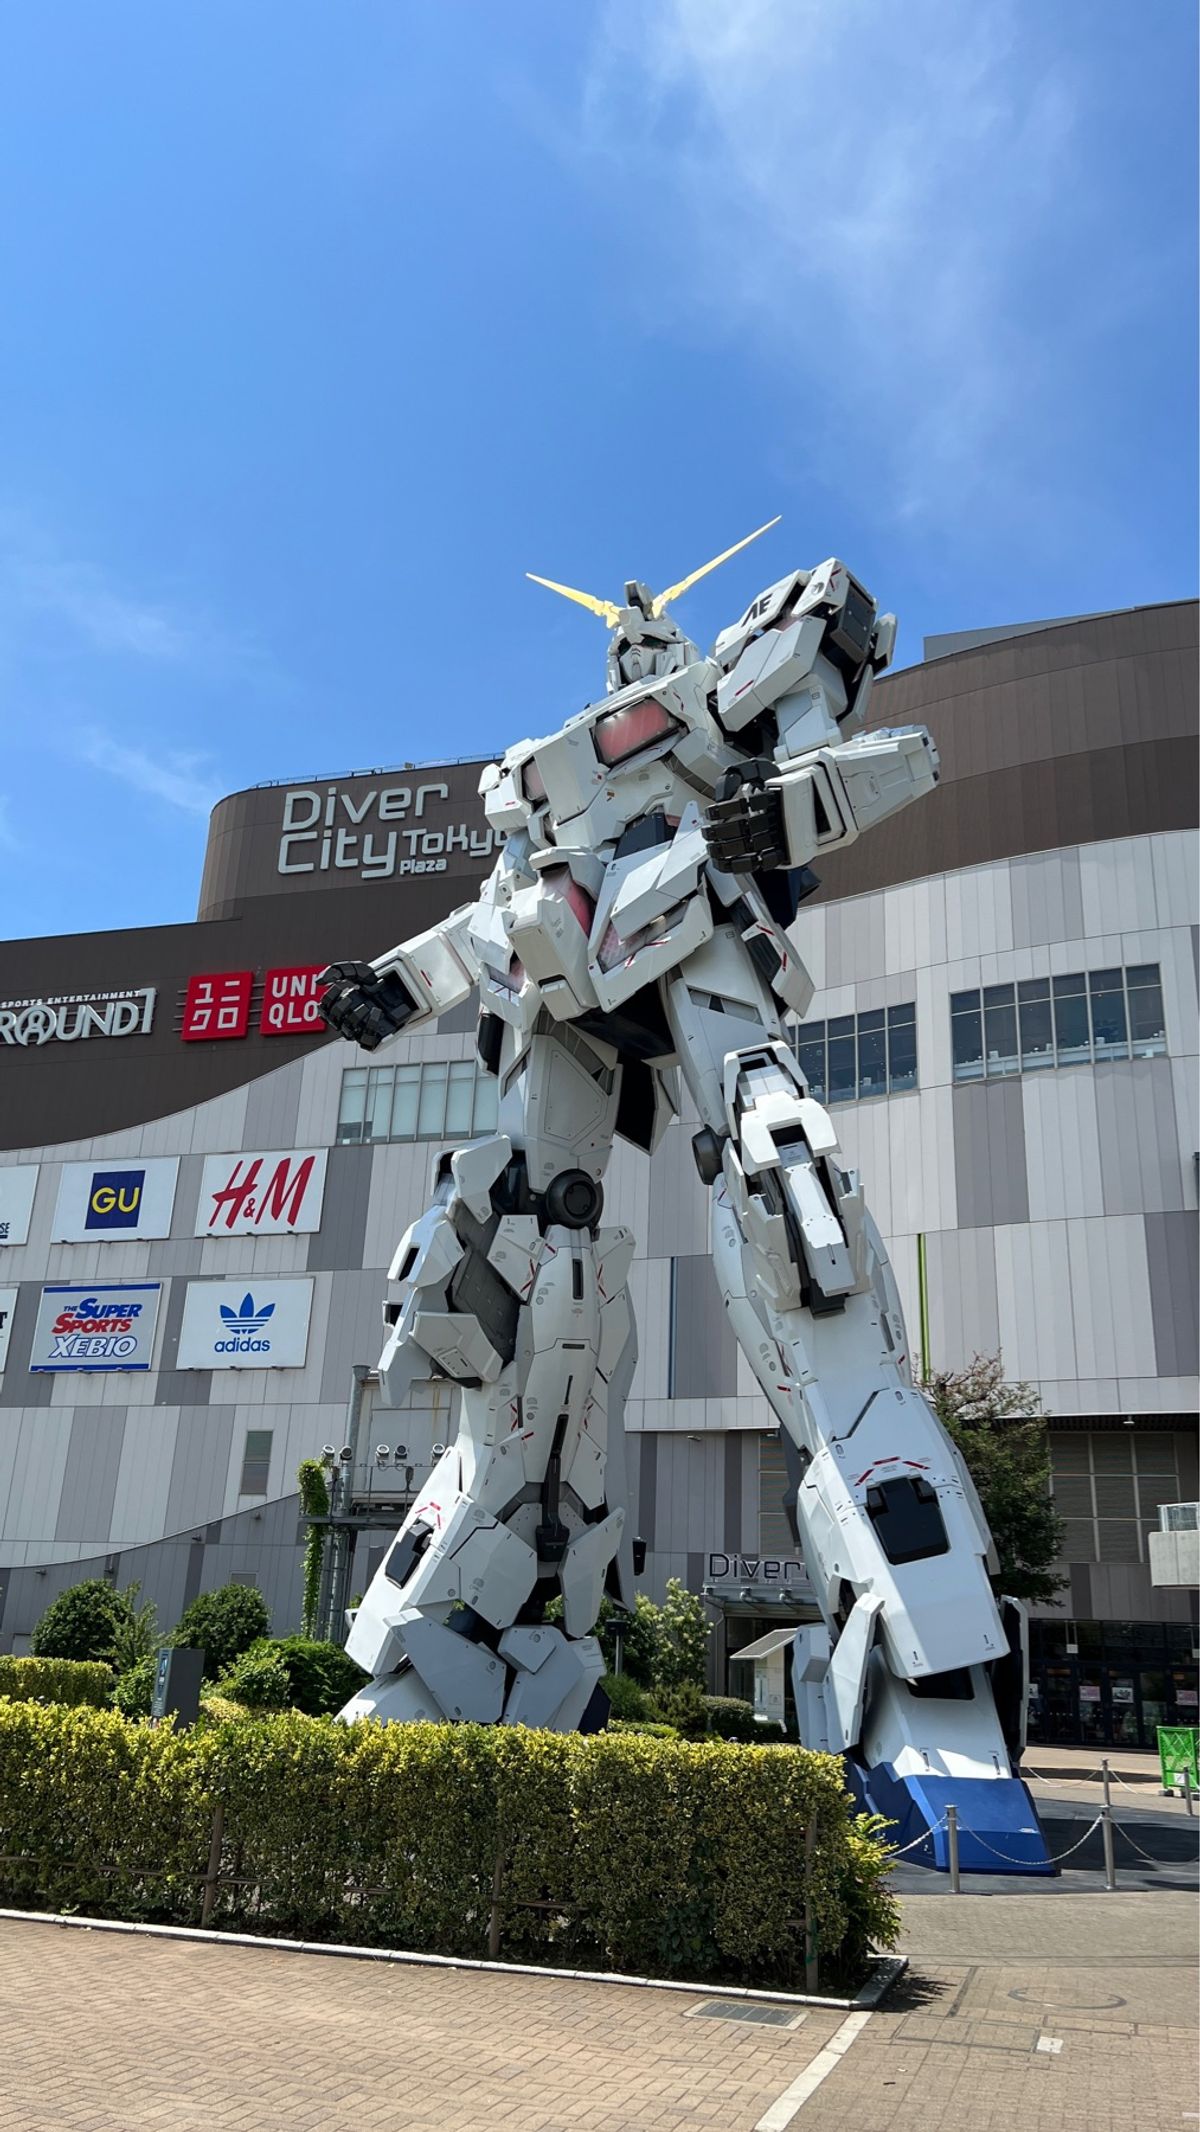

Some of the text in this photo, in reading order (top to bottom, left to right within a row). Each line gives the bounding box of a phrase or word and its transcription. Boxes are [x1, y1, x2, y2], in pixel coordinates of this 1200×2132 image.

[282, 783, 448, 831] Diver
[278, 828, 397, 879] City
[400, 858, 447, 875] Plaza
[272, 974, 318, 998] UNI
[1, 990, 141, 1009] SPORTS ENTERTAINMENT
[268, 1000, 321, 1028] QLO
[91, 1187, 140, 1214] GU
[208, 1155, 316, 1229] H&M
[75, 1297, 143, 1319] SUPER
[52, 1313, 133, 1334] SPORTS
[48, 1334, 138, 1358] XEBIO
[214, 1337, 271, 1353] adidas
[709, 1553, 809, 1580] Diver
